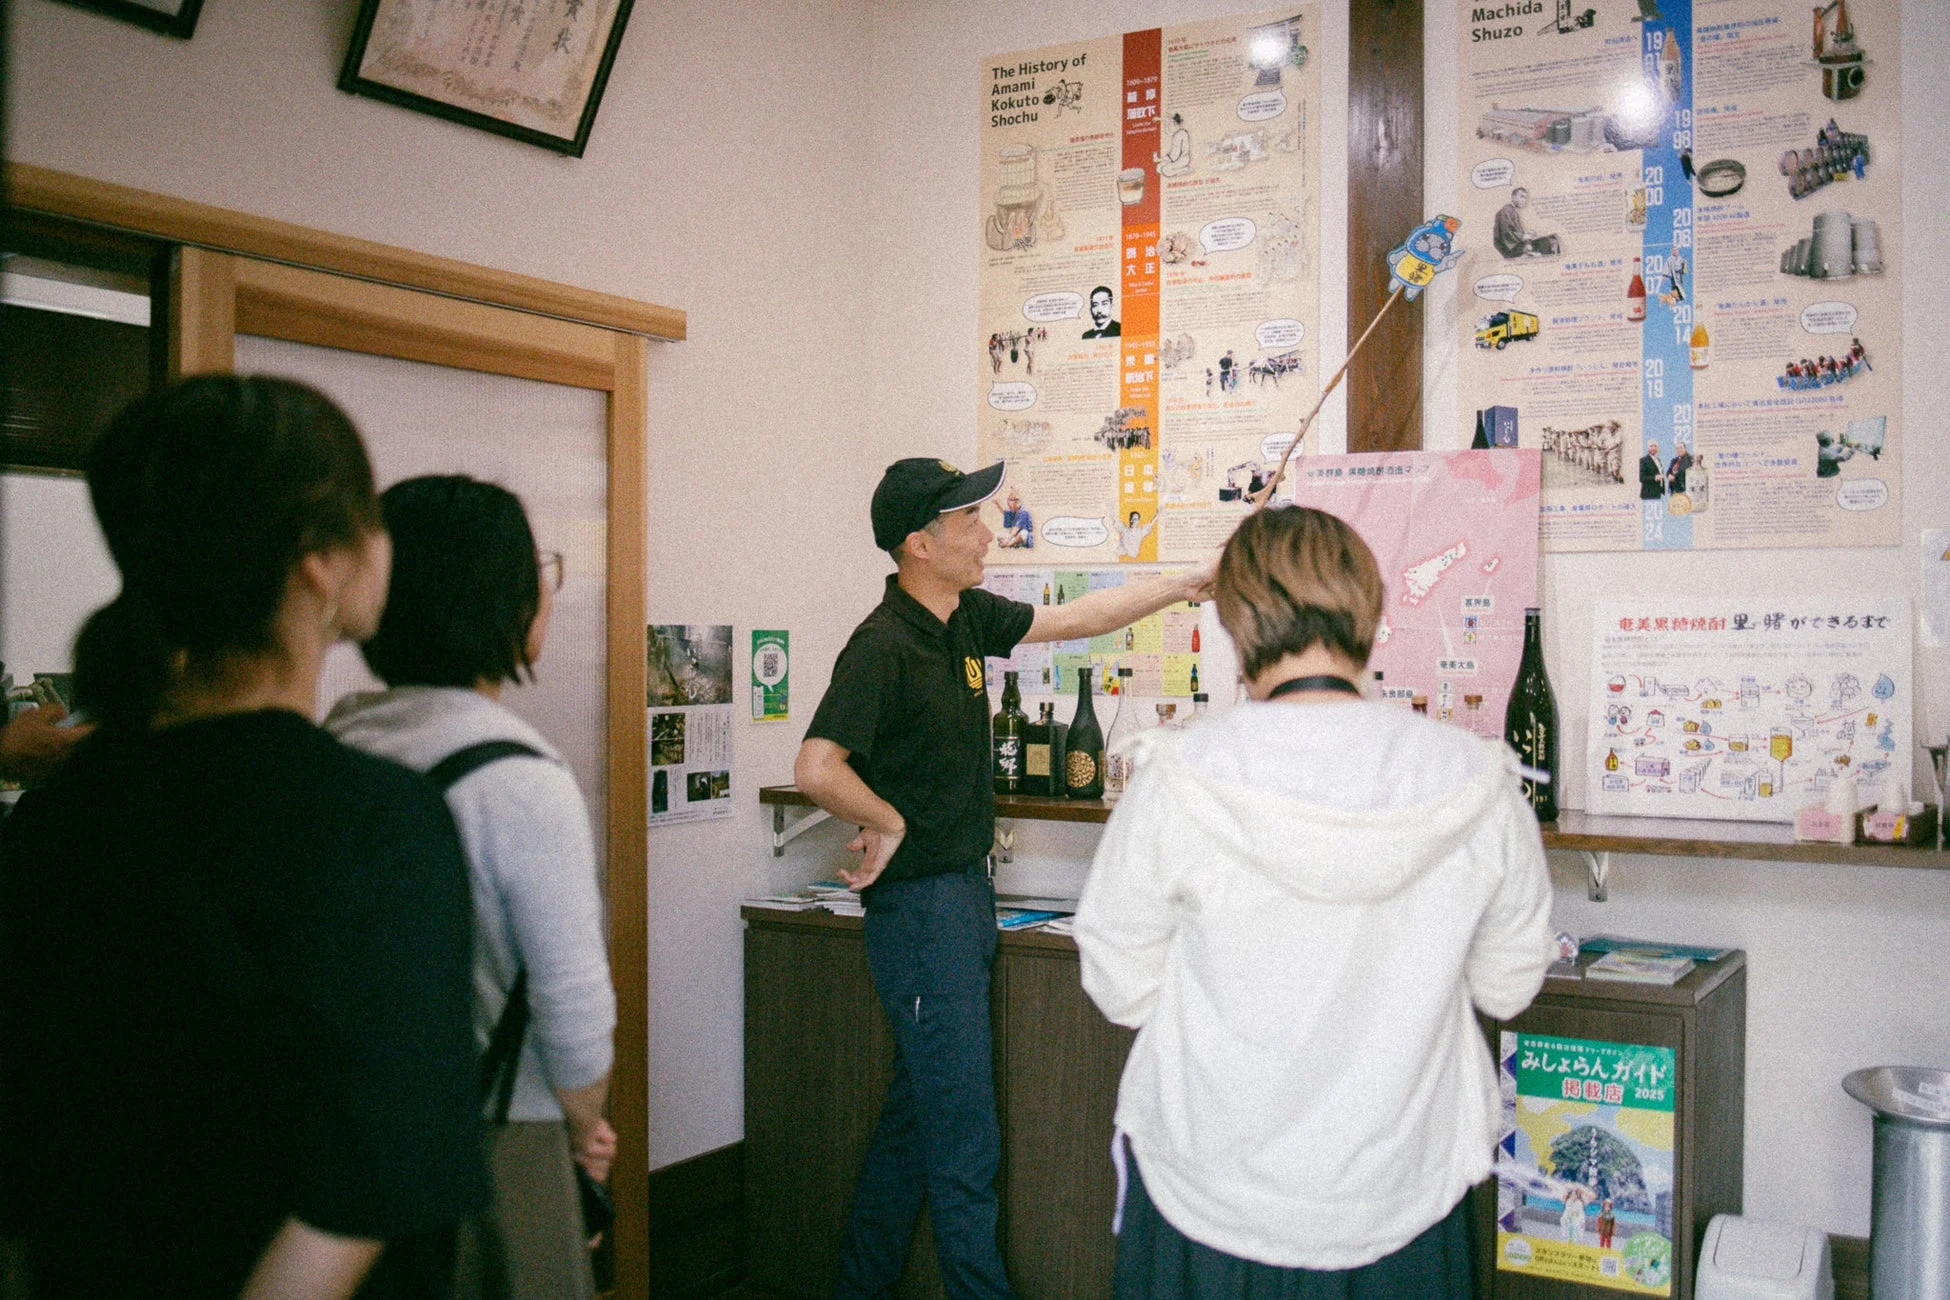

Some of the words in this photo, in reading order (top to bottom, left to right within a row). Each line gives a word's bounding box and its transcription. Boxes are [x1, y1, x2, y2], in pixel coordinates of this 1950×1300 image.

[1472, 1, 1542, 22] Machida
[1472, 26, 1523, 42] Shuzo
[992, 67, 1015, 80] The
[1019, 60, 1068, 76] History
[1072, 53, 1087, 67] of
[992, 77, 1035, 96] Amami
[991, 95, 1040, 112] Kokuto
[991, 111, 1038, 128] Shochu
[1674, 110, 1691, 129] 19
[1673, 130, 1692, 150] 98
[1645, 167, 1663, 185] 20
[1646, 187, 1663, 206] 00
[1673, 208, 1691, 227] 20
[1673, 229, 1691, 248] 08
[1126, 262, 1155, 276] 大正
[1645, 255, 1663, 275] 20
[1646, 276, 1663, 294] 07
[1673, 304, 1691, 324] 20
[1674, 326, 1691, 344] 14
[1645, 359, 1663, 377] 20
[1647, 379, 1663, 398] 19
[1674, 404, 1691, 423] 20
[1674, 425, 1691, 444] 22
[1645, 501, 1663, 520] 20
[1645, 522, 1664, 541] 24
[1790, 615, 1891, 631] ができるまで
[1440, 660, 1475, 669] 奄美大島
[1562, 1076, 1624, 1104] 掲載店
[1634, 1087, 1666, 1101] 2025
